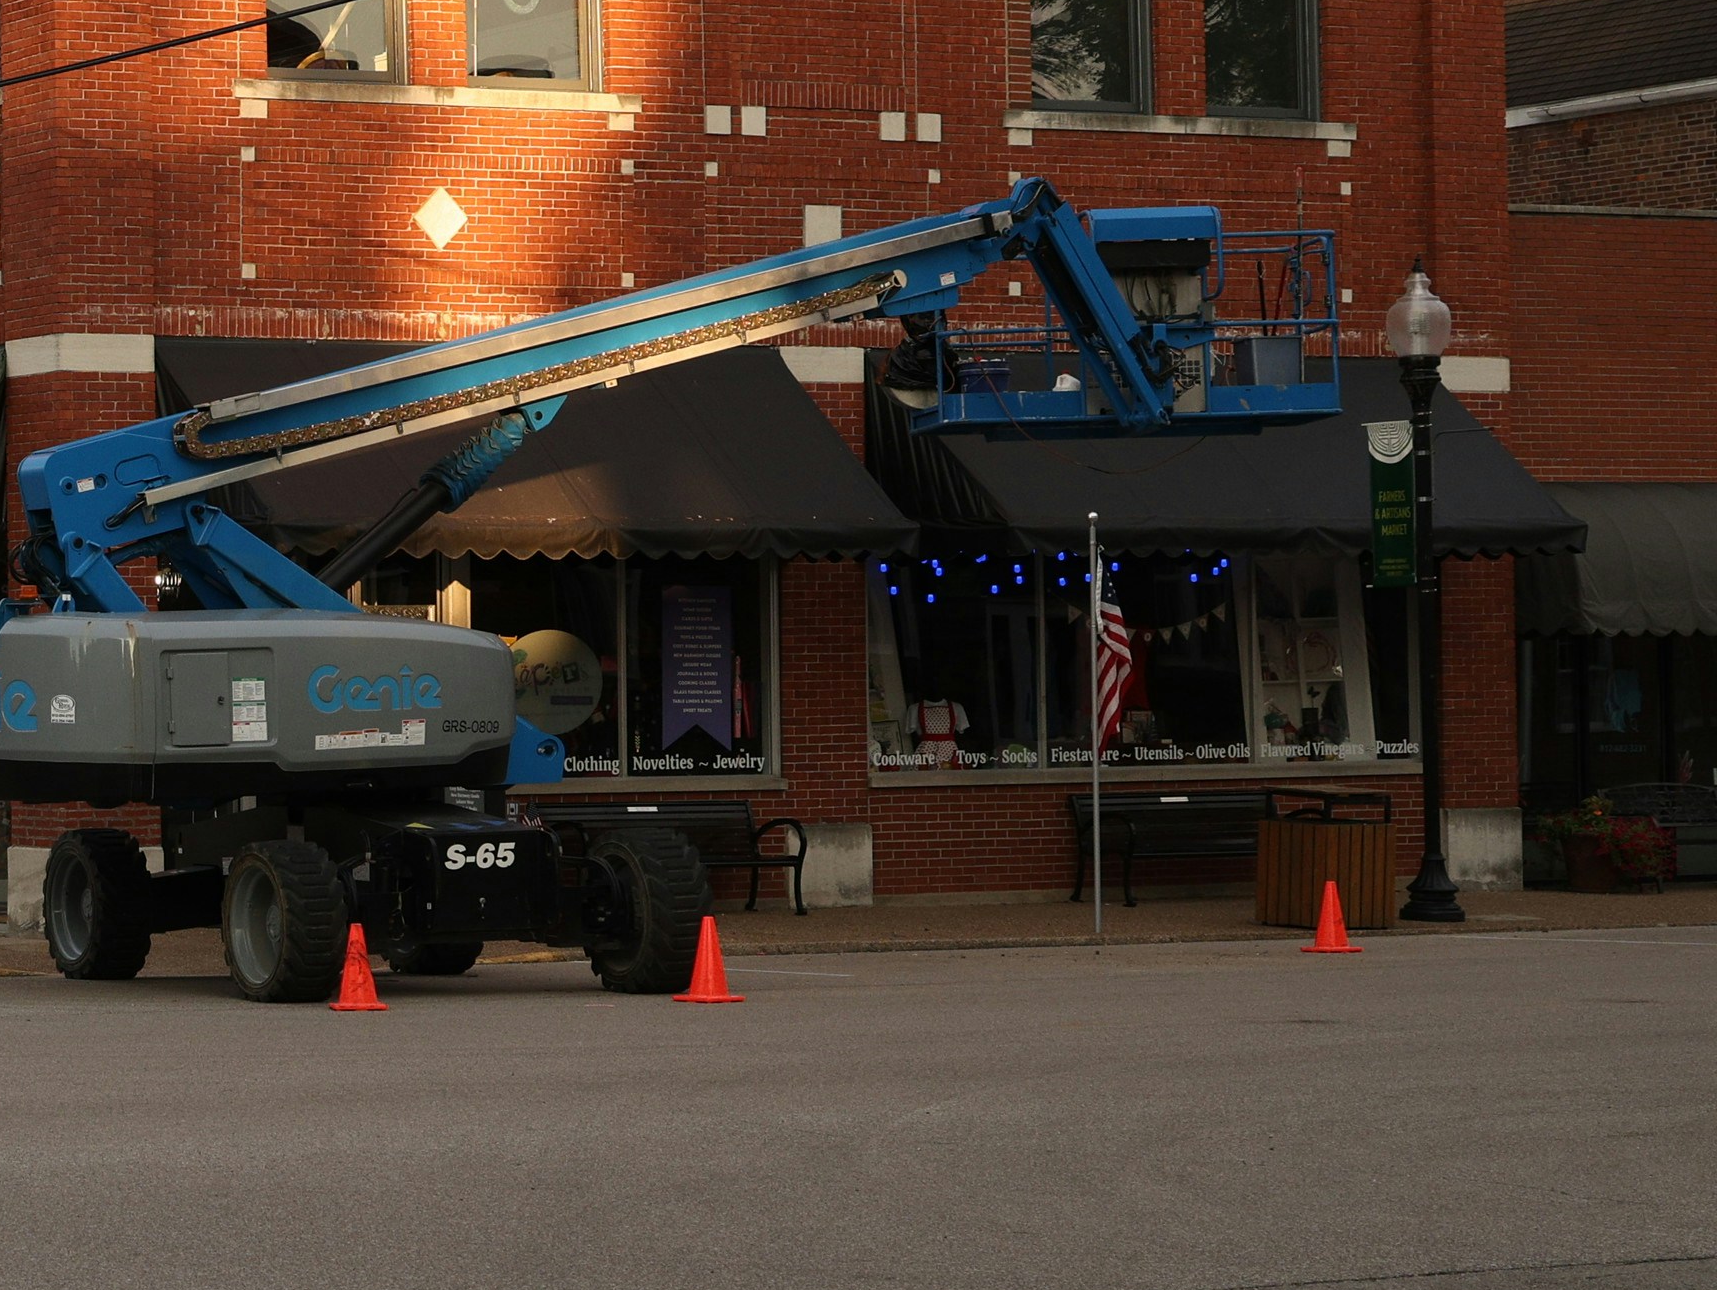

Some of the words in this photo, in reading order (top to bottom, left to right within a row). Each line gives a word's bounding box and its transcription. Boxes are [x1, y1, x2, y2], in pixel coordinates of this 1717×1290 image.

[1378, 490, 1406, 502] FARMERS
[1374, 508, 1380, 520] &
[1381, 506, 1411, 519] ARTISANS
[1381, 523, 1407, 536] MARKET
[307, 664, 443, 713] Genie
[442, 719, 500, 734] GRS-0809
[873, 751, 936, 767] Cookware
[956, 750, 987, 768] Toys
[1002, 748, 1038, 764] Socks
[1134, 744, 1184, 761] Utensils
[1196, 745, 1226, 760] Olive
[1227, 743, 1251, 758] Oils
[1261, 741, 1311, 758] Flavored
[1312, 741, 1365, 758] Vinegars
[1376, 739, 1420, 755] Puzzles
[564, 755, 620, 775] Clothing
[633, 754, 694, 771] Novelties
[712, 753, 765, 772] Jewelry
[444, 841, 516, 871] S-65
